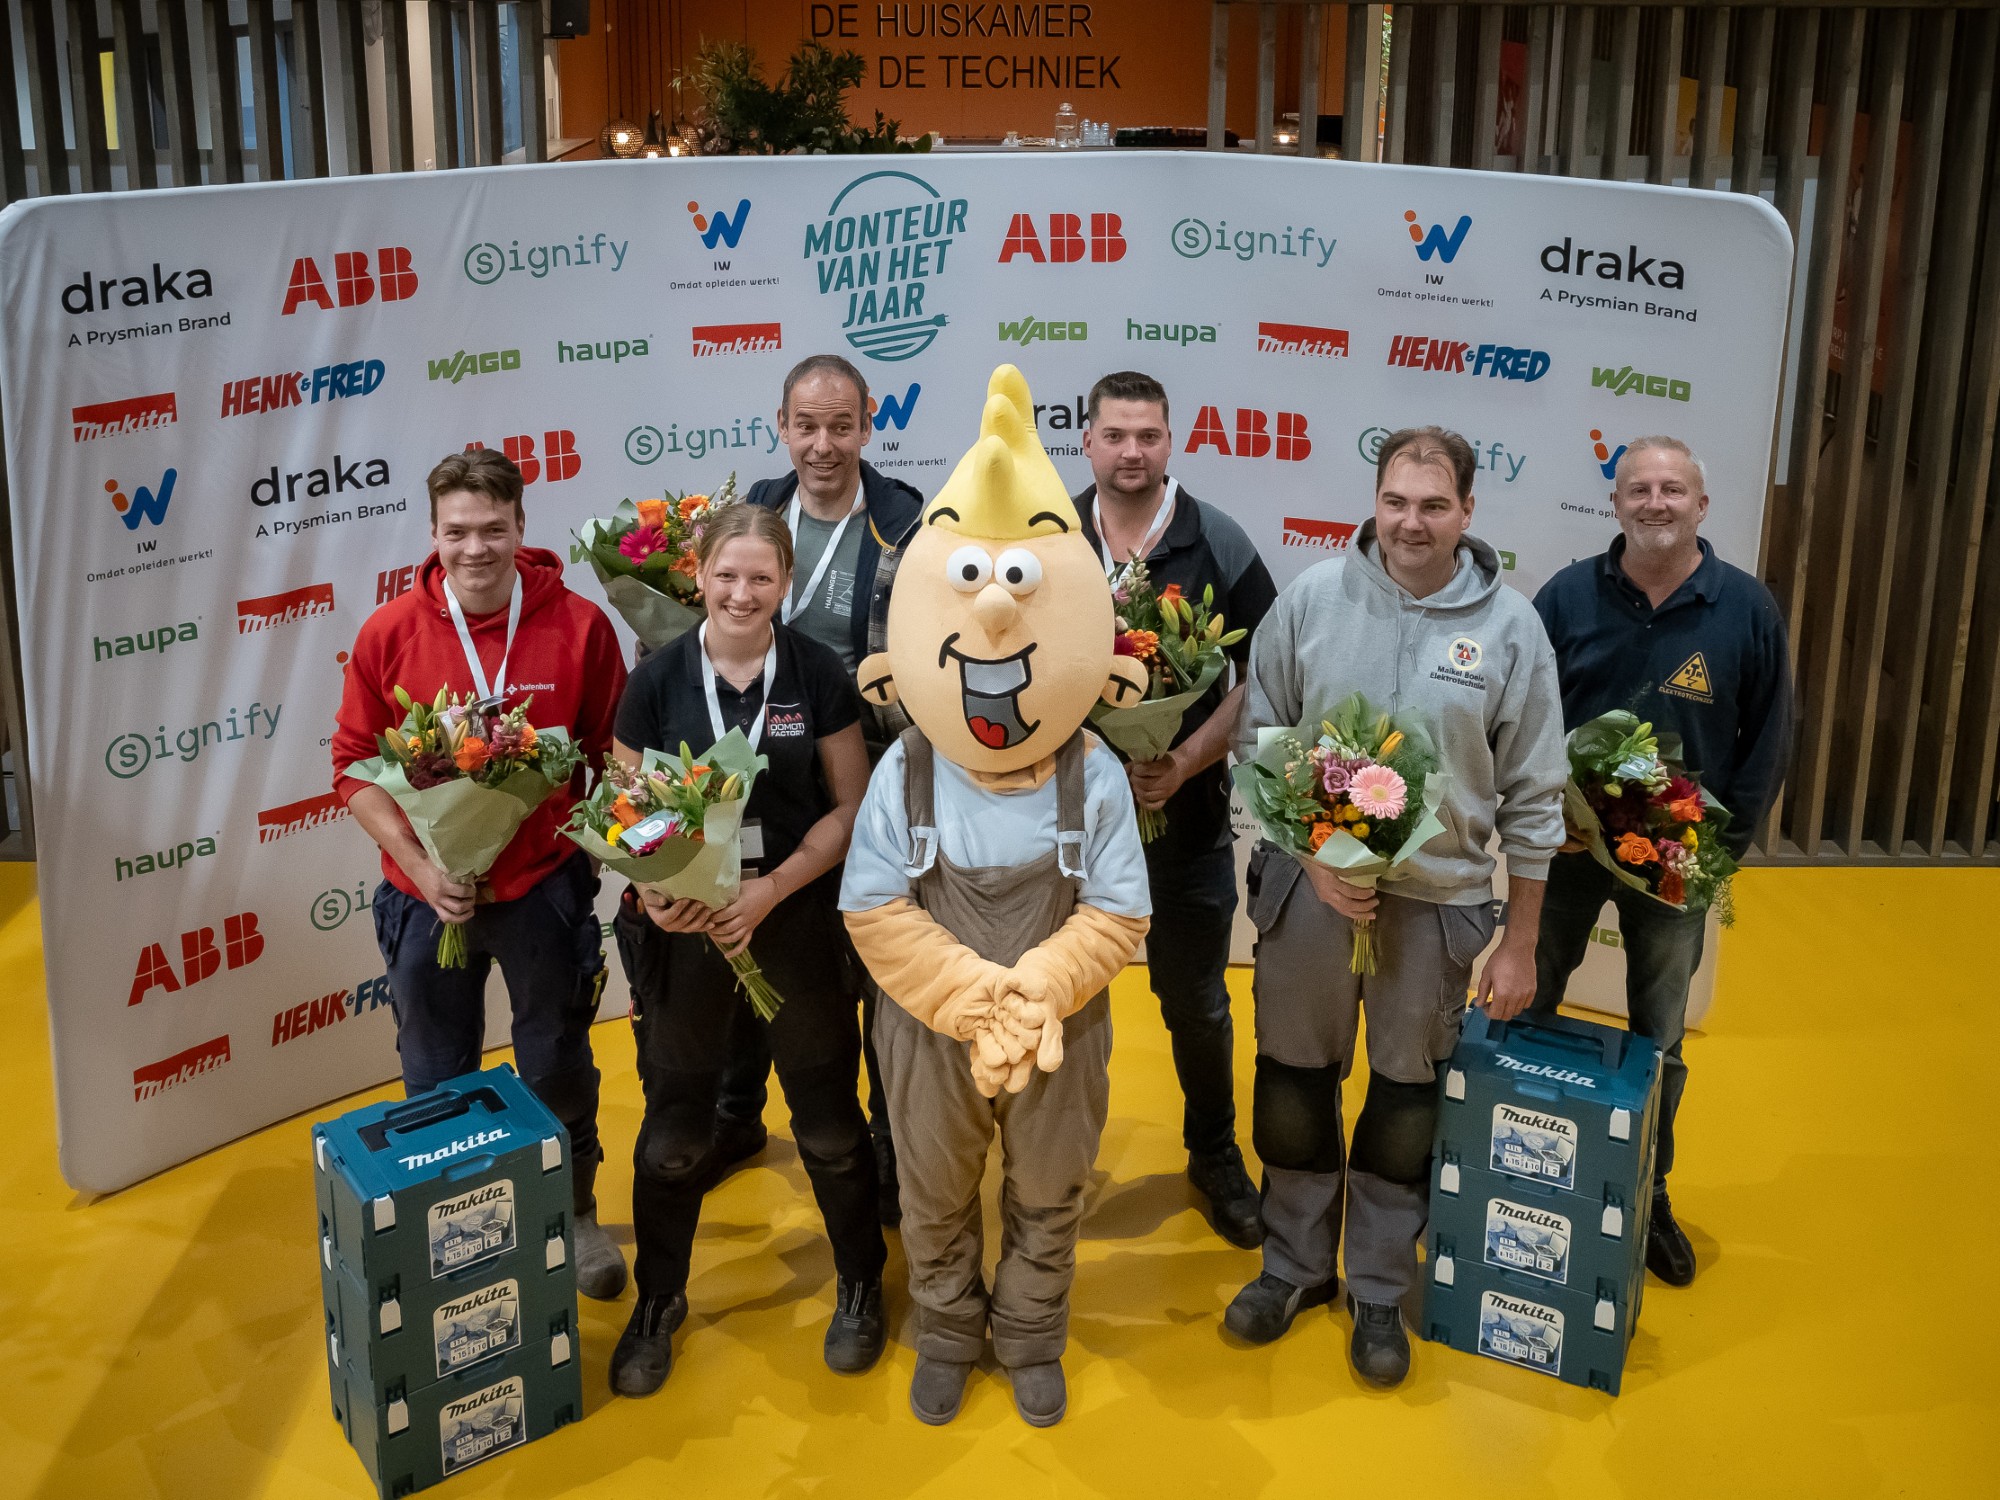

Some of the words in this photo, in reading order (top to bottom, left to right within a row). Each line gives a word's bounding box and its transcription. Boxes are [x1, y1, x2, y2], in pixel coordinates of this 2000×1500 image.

[811, 4, 859, 37] DE
[876, 3, 1093, 38] HUISKAMER
[879, 56, 926, 88] DE
[938, 56, 1121, 89] TECHNIEK
[804, 199, 968, 259] MONTEUR
[998, 213, 1127, 263] ABB
[281, 246, 419, 316] ABB
[714, 261, 731, 271] IW
[816, 250, 880, 294] VAN
[888, 239, 953, 282] HET
[1425, 274, 1444, 285] IW
[1540, 237, 1685, 290] draka
[61, 263, 213, 315] draka
[670, 281, 702, 290] Omdat
[706, 277, 747, 290] opleiden
[750, 276, 780, 287] werkt!
[1377, 288, 1412, 299] Omdat
[1415, 291, 1459, 306] opleiden
[1462, 295, 1494, 308] werkt!
[842, 282, 925, 328] JAAR
[1540, 288, 1554, 302] A
[1558, 290, 1639, 314] Prysmian
[1644, 302, 1698, 323] Brand
[68, 334, 82, 348] A
[86, 321, 173, 345] Prysmian
[178, 312, 231, 331] Brand
[999, 315, 1088, 346] WAGO
[1127, 318, 1216, 346] haupa
[428, 349, 521, 385] WAGO
[558, 339, 649, 363] haupa
[1592, 365, 1691, 402] WAGO
[882, 442, 900, 452] IW
[1185, 406, 1311, 461] ABB
[874, 459, 915, 468] opleiden
[917, 457, 947, 467] werkt!
[250, 455, 390, 507] draka
[255, 525, 270, 538] A
[274, 508, 352, 535] Prysmian
[357, 498, 407, 519] Brand
[1561, 502, 1595, 515] Omdat
[137, 540, 157, 553] IW
[87, 567, 125, 582] Omdat
[128, 557, 175, 575] opleiden
[178, 548, 213, 565] werkt!
[824, 569, 838, 609] HALLINGER
[93, 621, 198, 662] haupa
[115, 837, 216, 882] haupa
[127, 911, 265, 1007] ABB
[1495, 1054, 1596, 1088] makita
[1501, 1107, 1570, 1136] makita
[399, 1128, 511, 1170] makita
[435, 1185, 507, 1219] makita
[1494, 1201, 1564, 1231] makita
[440, 1284, 511, 1320] makita
[1489, 1293, 1557, 1324] makita
[446, 1382, 516, 1419] makita
